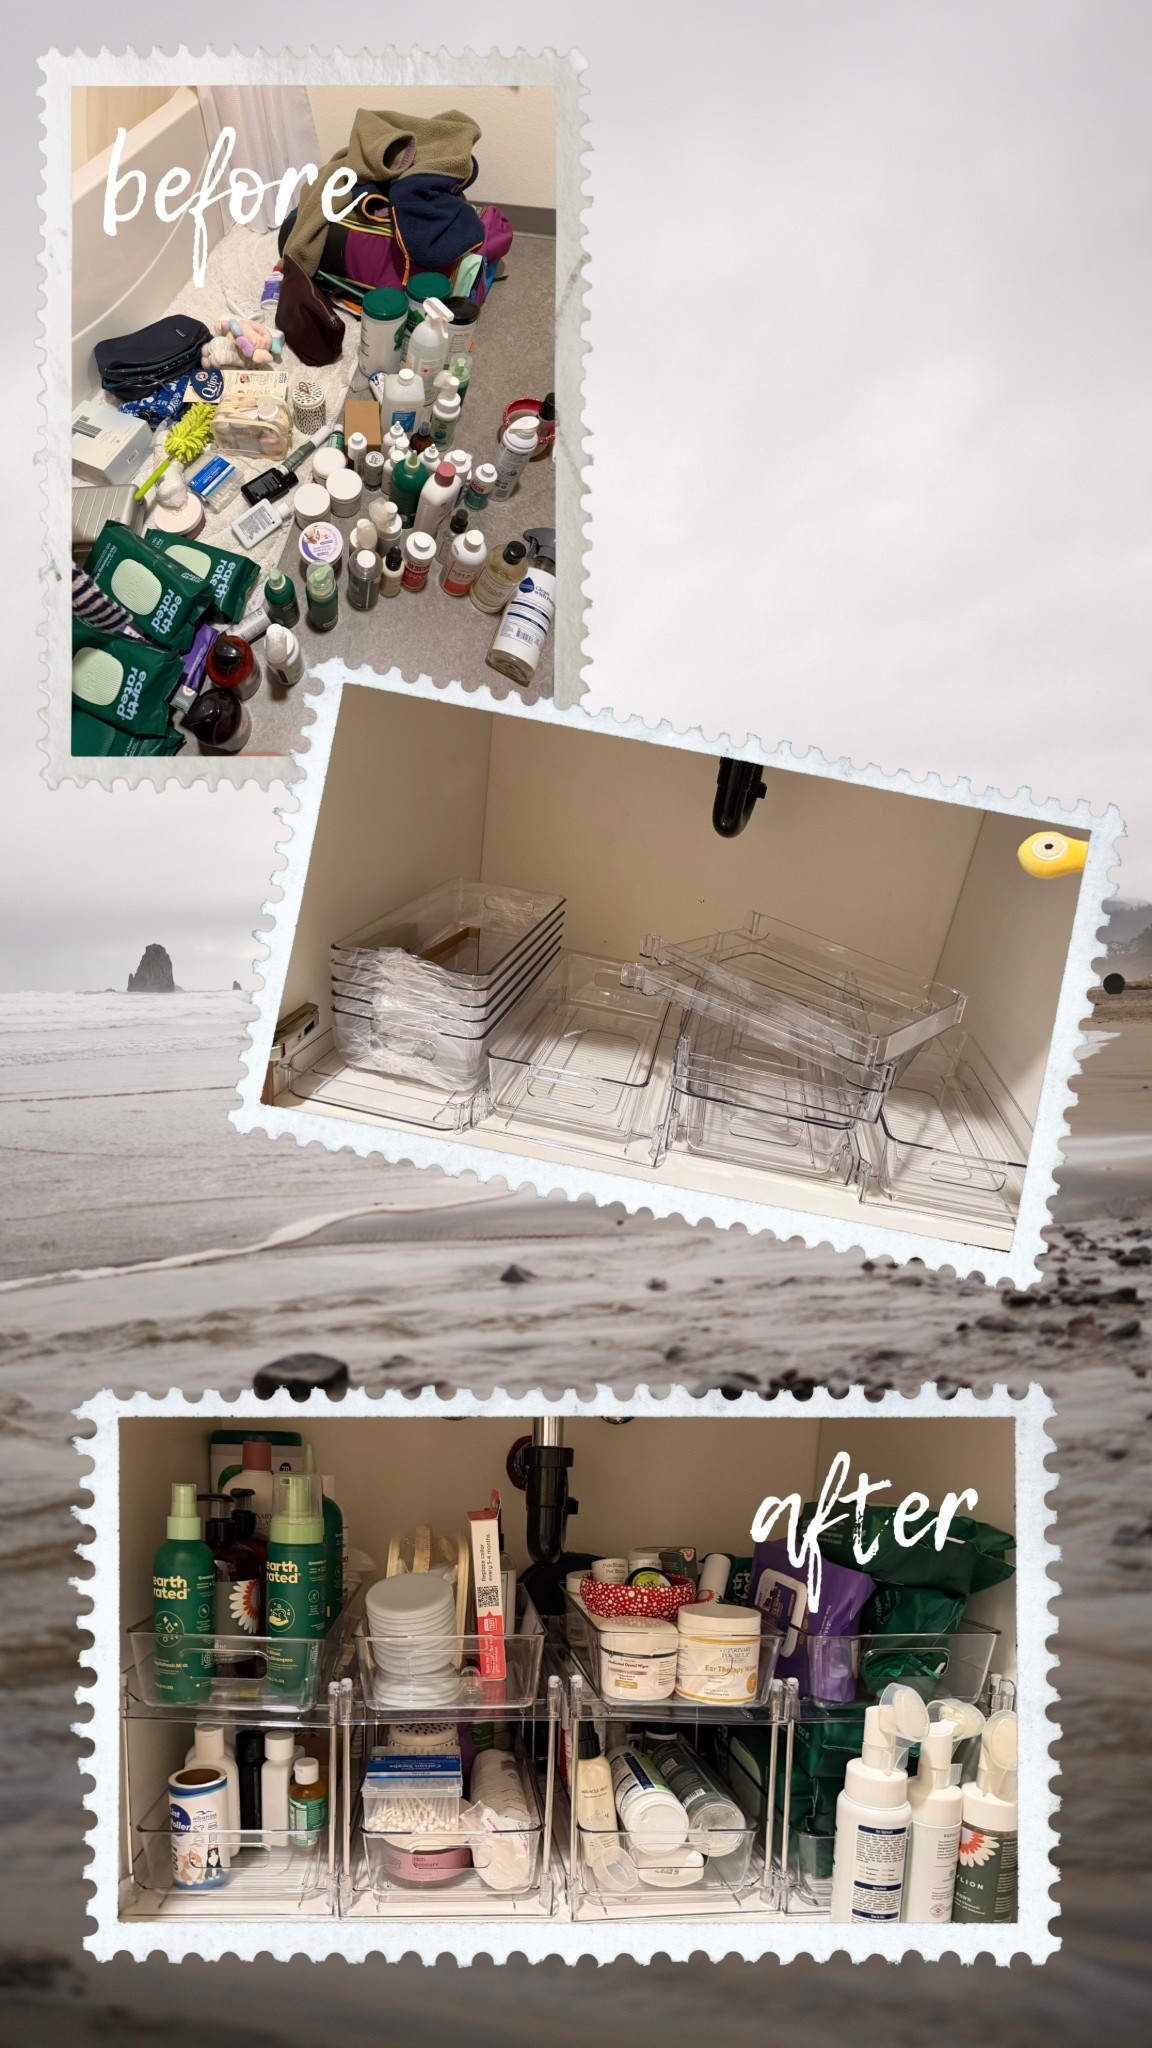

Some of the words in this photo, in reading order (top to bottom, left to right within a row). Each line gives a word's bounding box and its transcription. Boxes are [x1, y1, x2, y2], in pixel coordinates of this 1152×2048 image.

[209, 559, 228, 588] rate
[214, 561, 237, 599] earth
[150, 589, 175, 631] rated
[159, 595, 183, 635] earth
[117, 666, 139, 718] rated
[127, 670, 147, 721] earth
[153, 1575, 187, 1588] earth
[266, 1560, 298, 1573] earth
[153, 1588, 188, 1600] rated
[705, 1664, 717, 1672] Ear
[718, 1665, 744, 1674] Therapy
